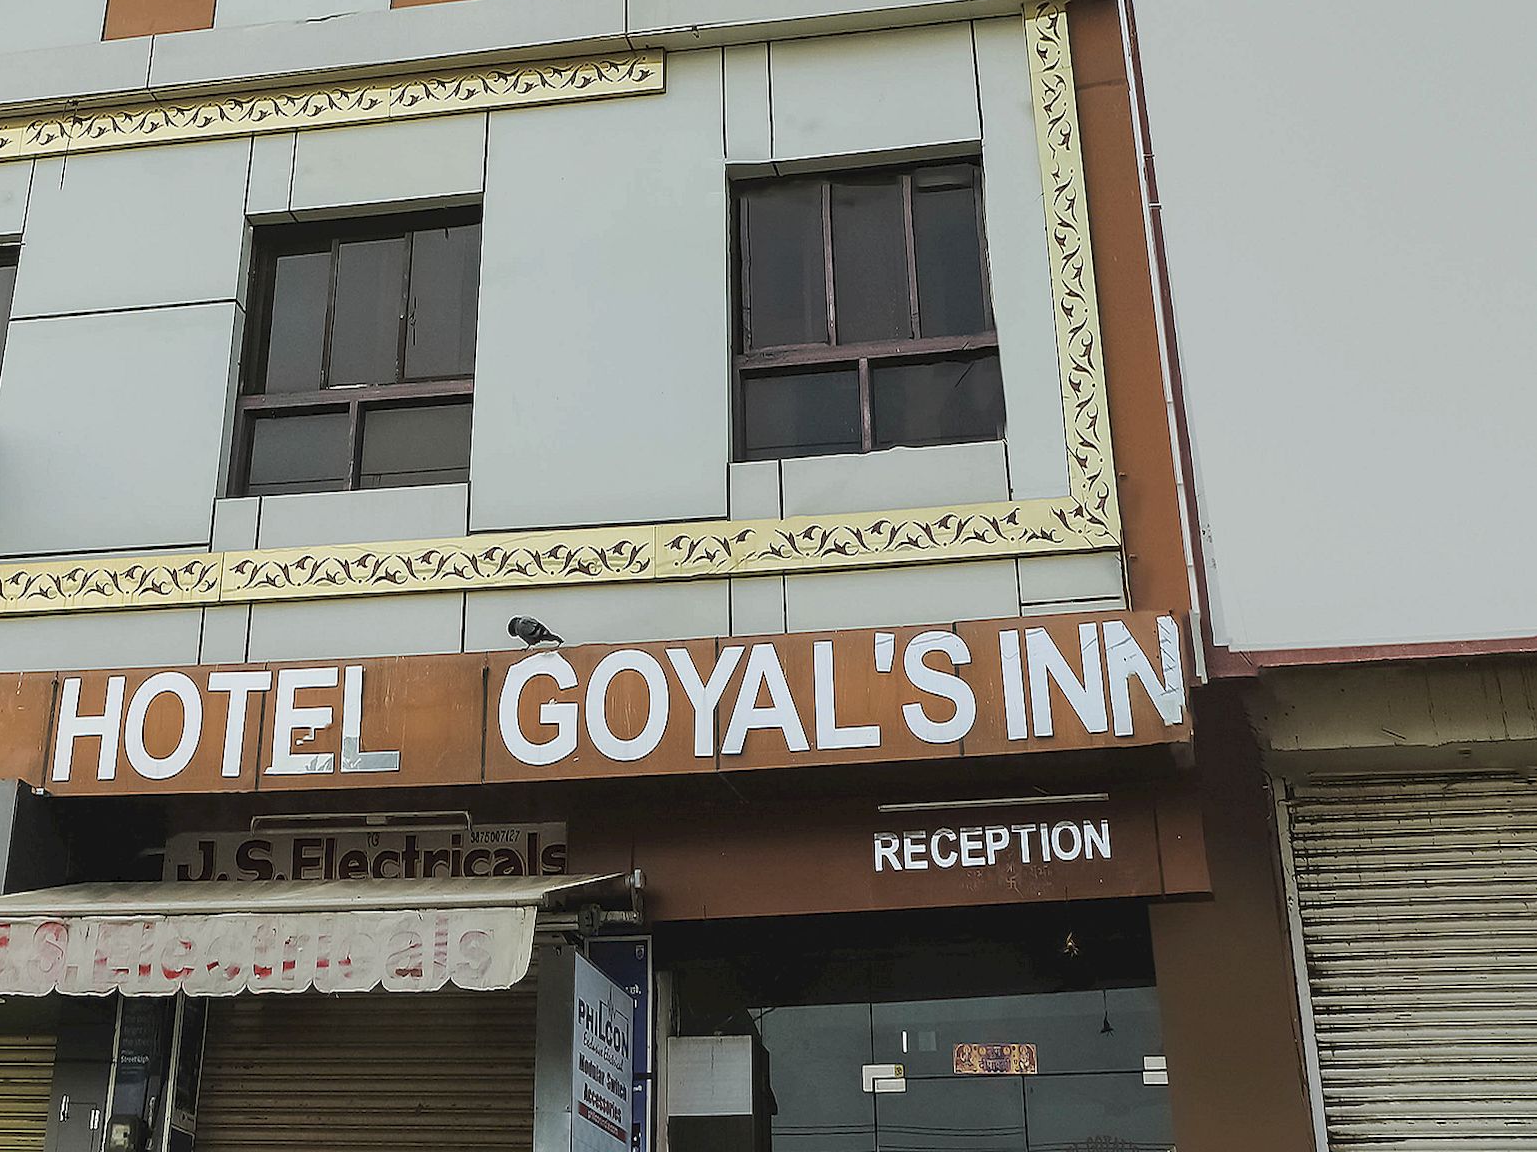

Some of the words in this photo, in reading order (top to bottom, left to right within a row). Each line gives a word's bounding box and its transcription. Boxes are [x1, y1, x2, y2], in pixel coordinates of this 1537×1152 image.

[51, 665, 401, 782] HOTEL
[497, 629, 979, 766] GOYAL'S
[997, 614, 1183, 743] INN
[873, 819, 1112, 872] RECEPTION
[578, 997, 629, 1060] PHILCON
[578, 1051, 605, 1087] Modular
[605, 1070, 627, 1102] Switch
[583, 1081, 622, 1124] Accessories
